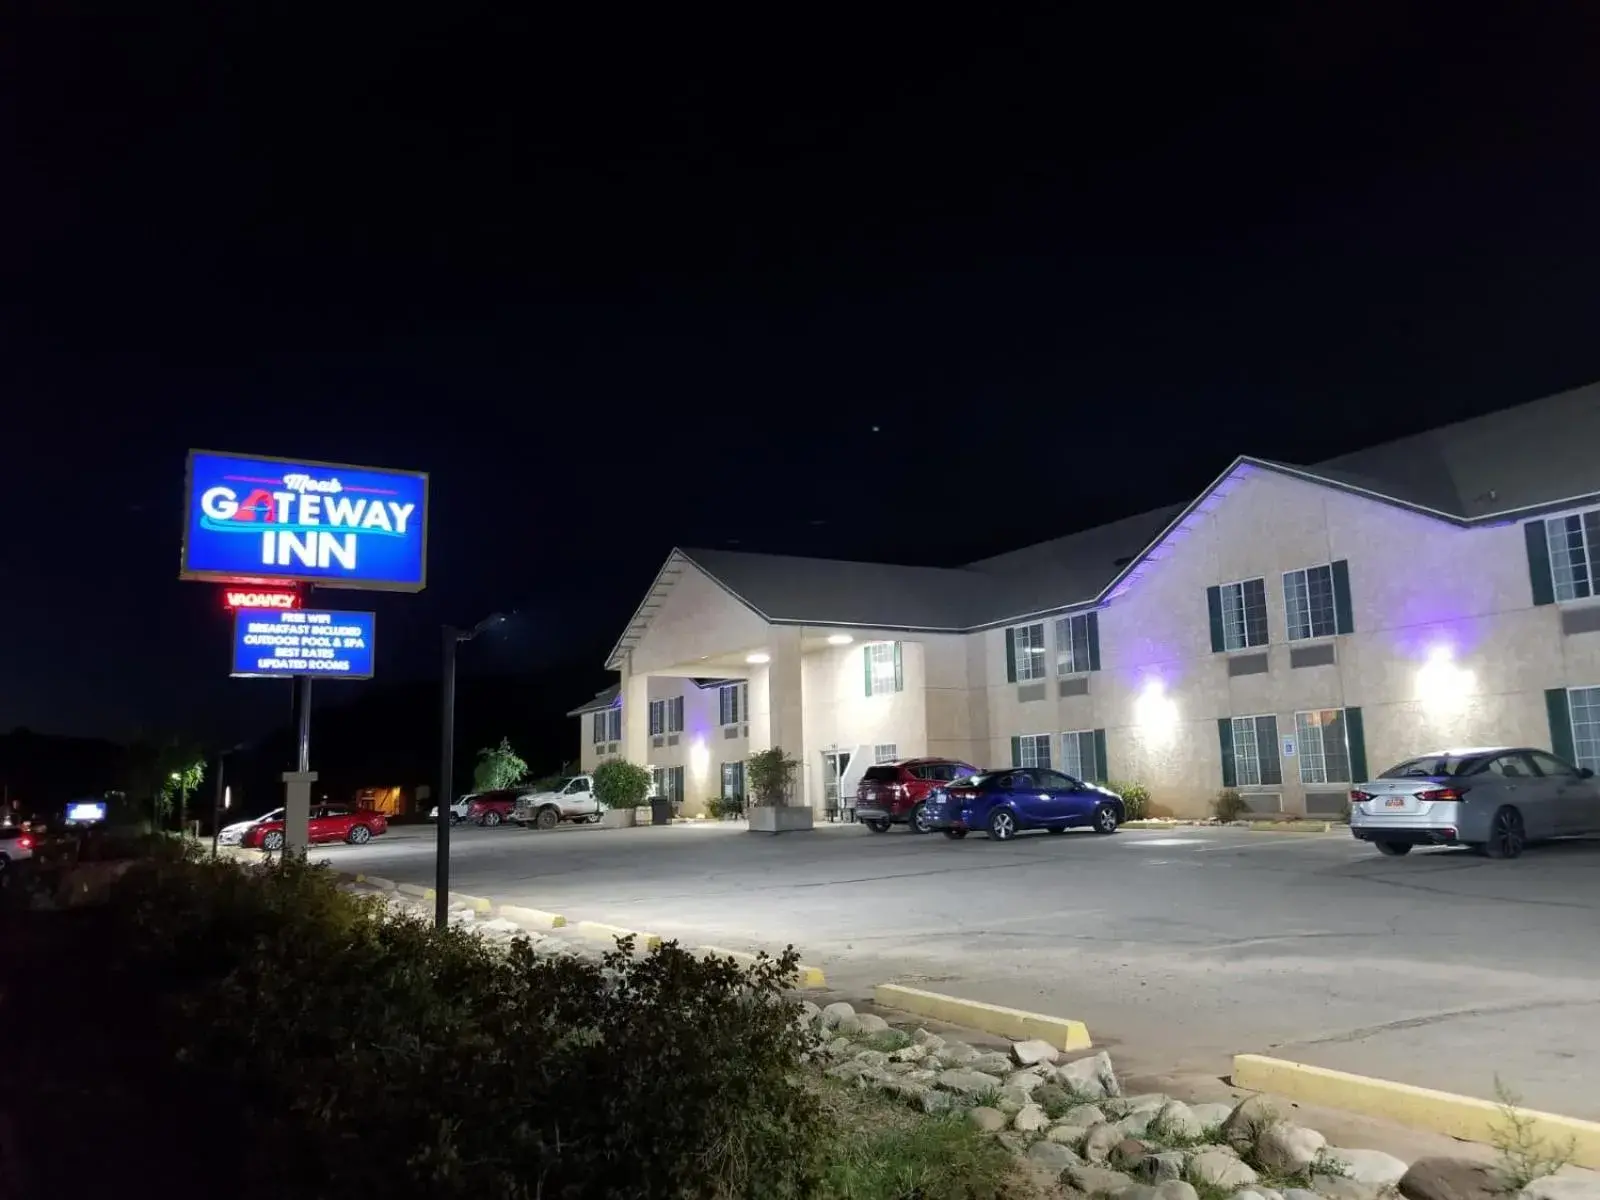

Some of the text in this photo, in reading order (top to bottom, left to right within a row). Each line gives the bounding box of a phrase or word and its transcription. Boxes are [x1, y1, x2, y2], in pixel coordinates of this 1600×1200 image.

[201, 487, 415, 533] GATEWAY
[262, 531, 356, 569] INN
[227, 592, 295, 607] VACANCY
[282, 613, 306, 623] FREE
[248, 623, 362, 636] BREAKFAST INCLUDED
[244, 635, 365, 648] OUTDOOR POOL & SPA
[275, 647, 335, 658] BEST RATES
[258, 658, 350, 670] UPDATED ROOMS
